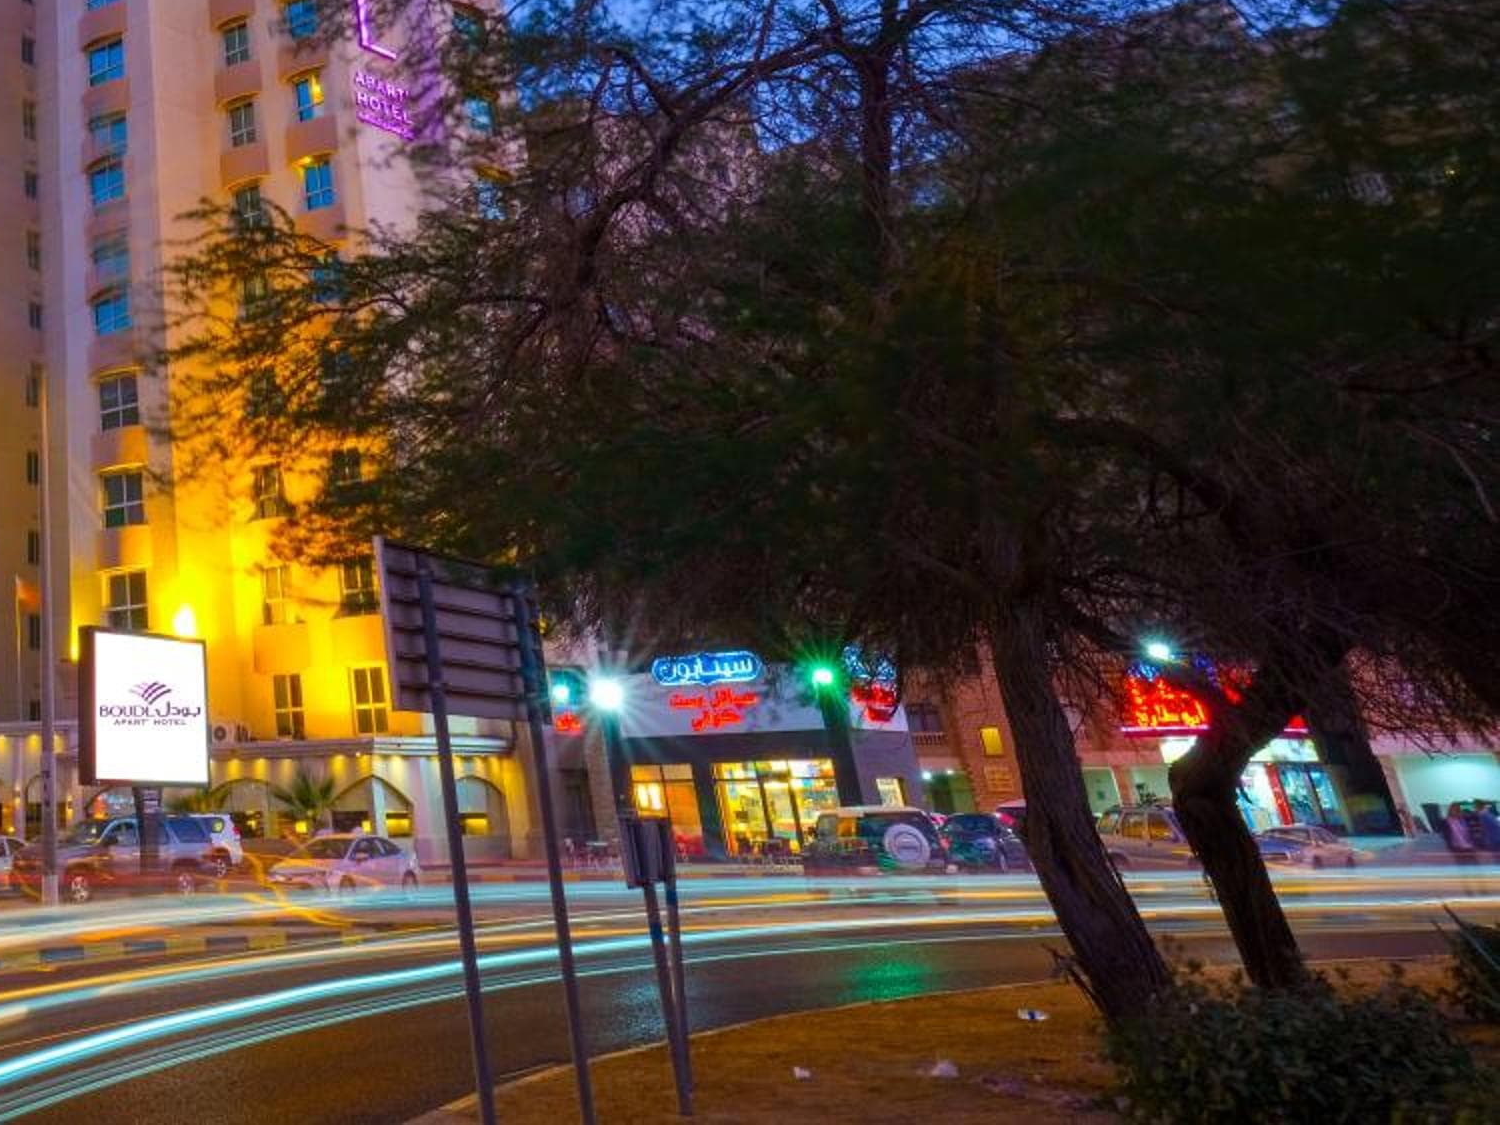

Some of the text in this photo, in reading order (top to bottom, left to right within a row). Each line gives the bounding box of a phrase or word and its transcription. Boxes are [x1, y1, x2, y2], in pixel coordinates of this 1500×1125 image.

[357, 91, 414, 125] HOTEL
[99, 705, 155, 717] BOUDL
[155, 700, 201, 718] بودل
[153, 718, 186, 726] HOTEL
